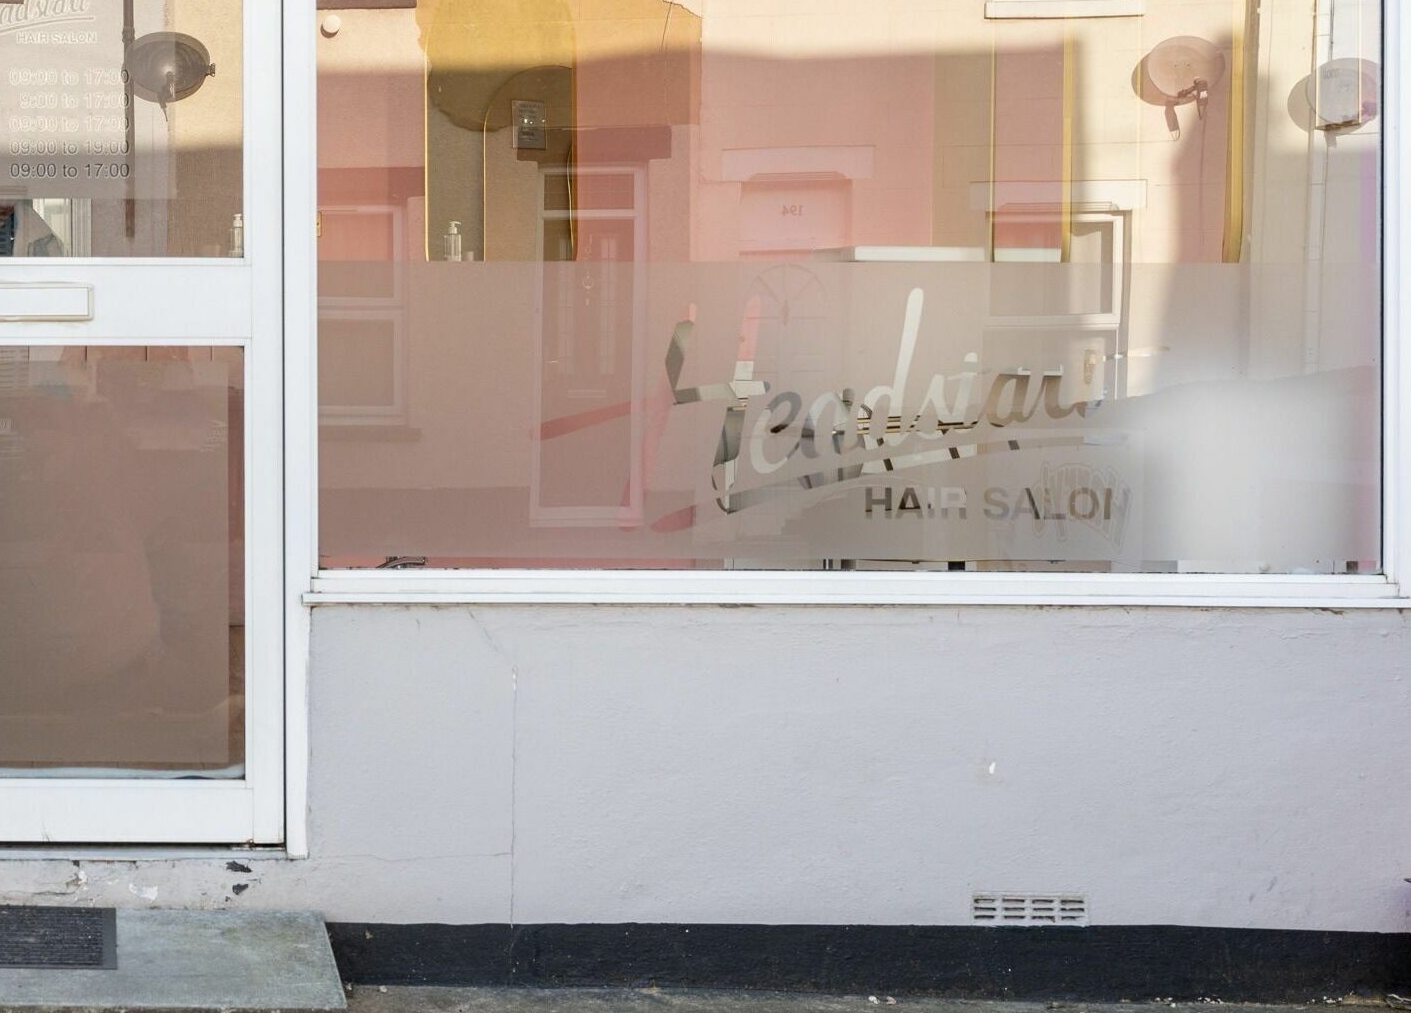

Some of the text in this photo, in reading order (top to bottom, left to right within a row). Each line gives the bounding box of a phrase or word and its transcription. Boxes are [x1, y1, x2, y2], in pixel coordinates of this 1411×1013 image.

[16, 31, 98, 45] HAIR SALON
[10, 69, 57, 85] 09:00
[62, 70, 79, 85] to
[84, 69, 130, 85] 17:00
[62, 93, 78, 108] to
[84, 92, 130, 108] 17:00
[61, 116, 78, 132] to
[10, 139, 57, 155] 09:00
[62, 141, 78, 155] to
[84, 139, 130, 155] 19:00
[10, 162, 57, 178] 09:00
[62, 164, 78, 178] to
[84, 162, 130, 178] 17:00
[864, 487, 969, 520] HAIR
